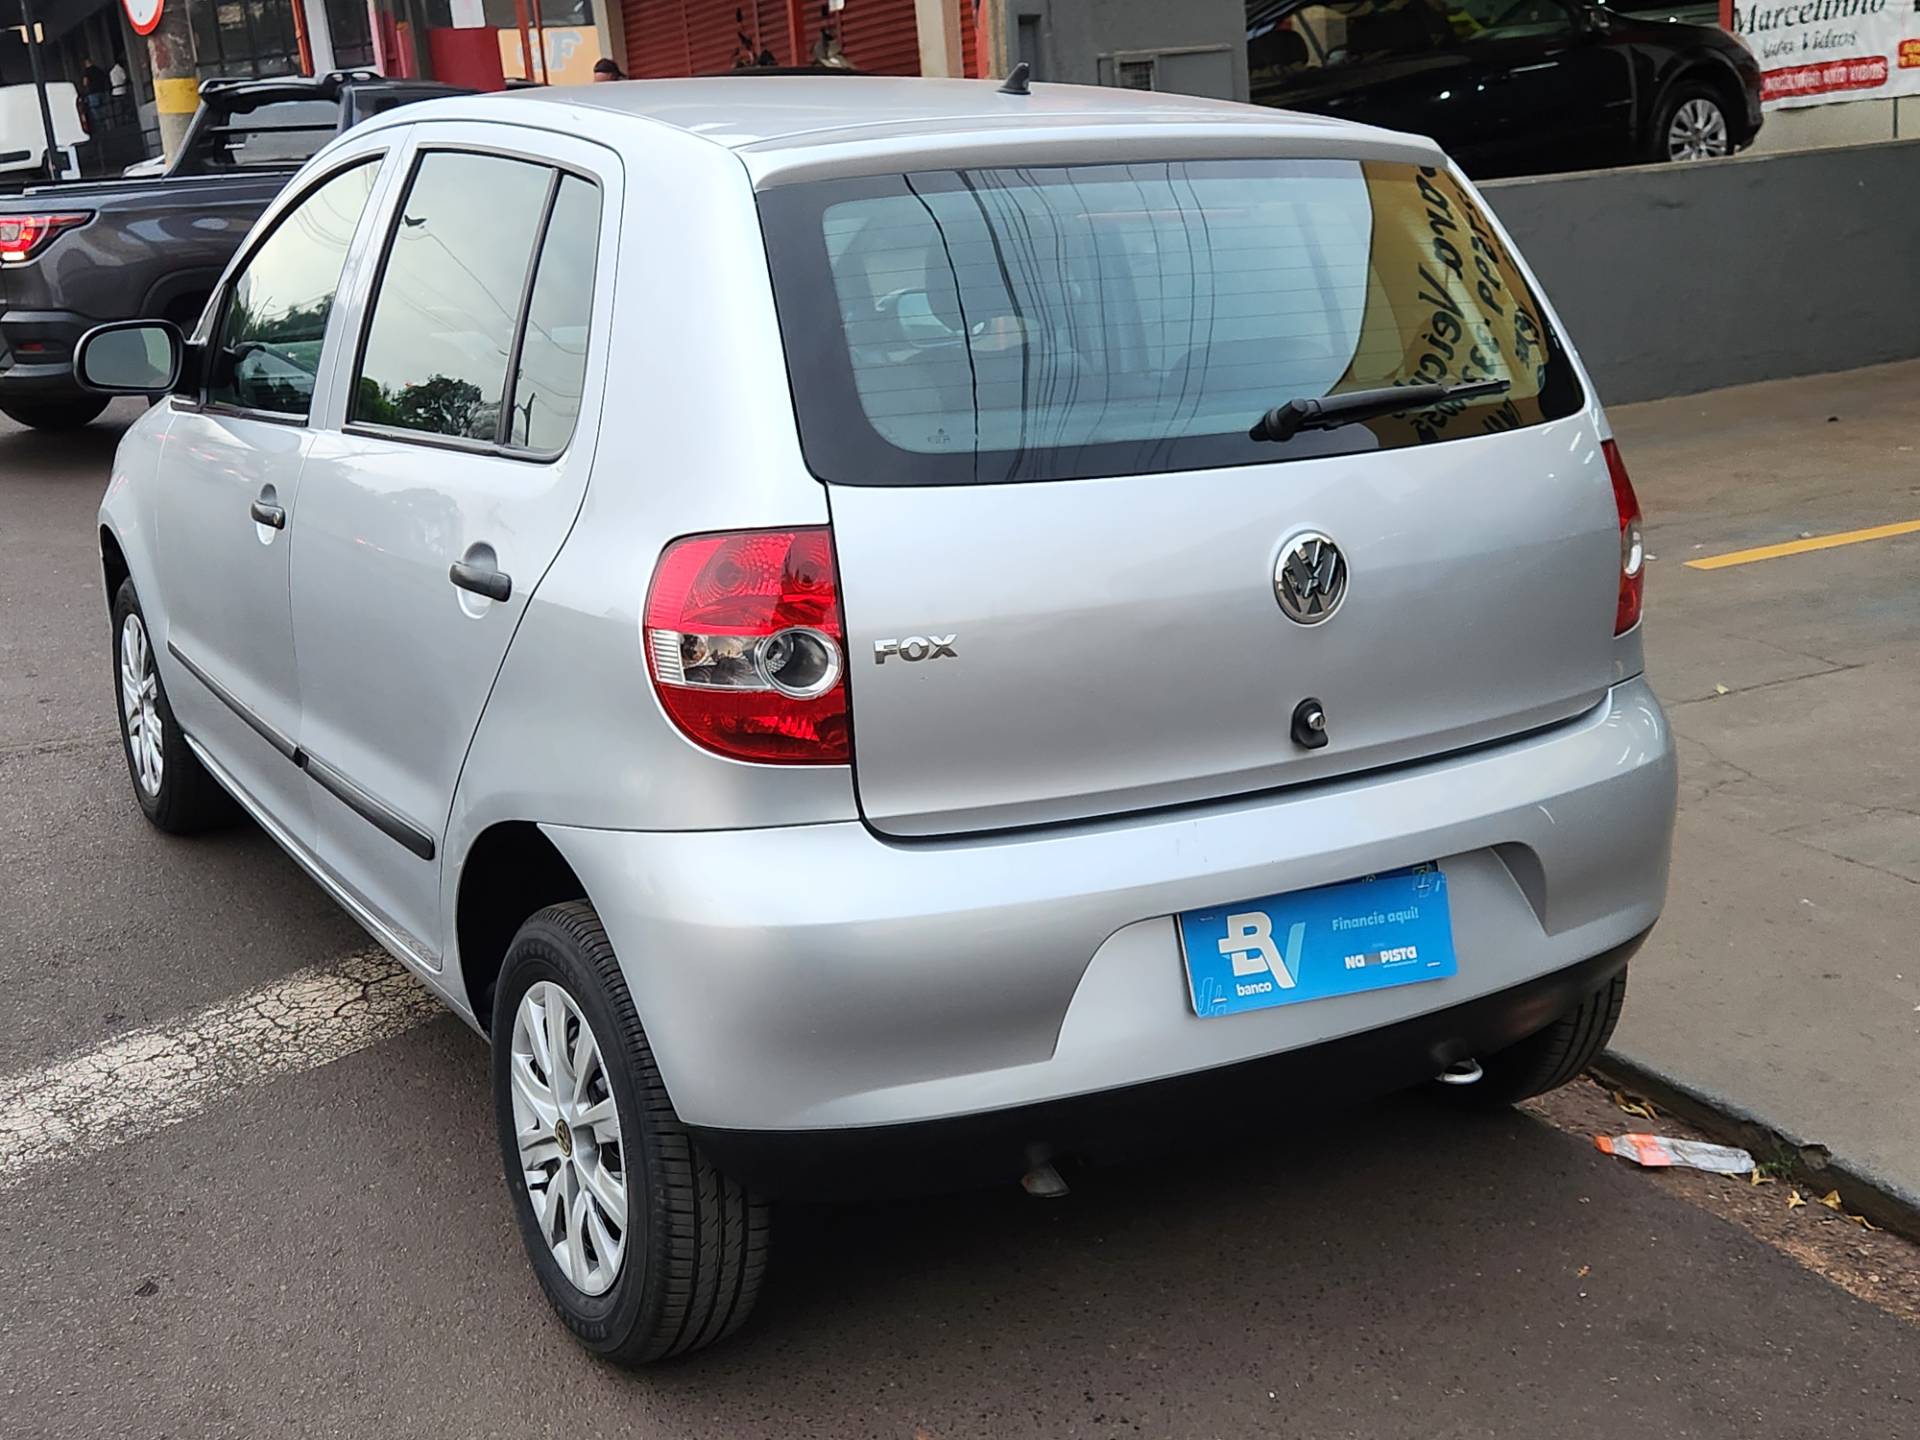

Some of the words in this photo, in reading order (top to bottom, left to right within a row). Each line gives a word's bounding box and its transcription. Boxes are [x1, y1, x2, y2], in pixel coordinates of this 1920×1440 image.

[874, 633, 959, 665] FOX
[1331, 910, 1386, 931] Financie
[1387, 906, 1420, 926] aqui!
[1236, 981, 1272, 997] banco
